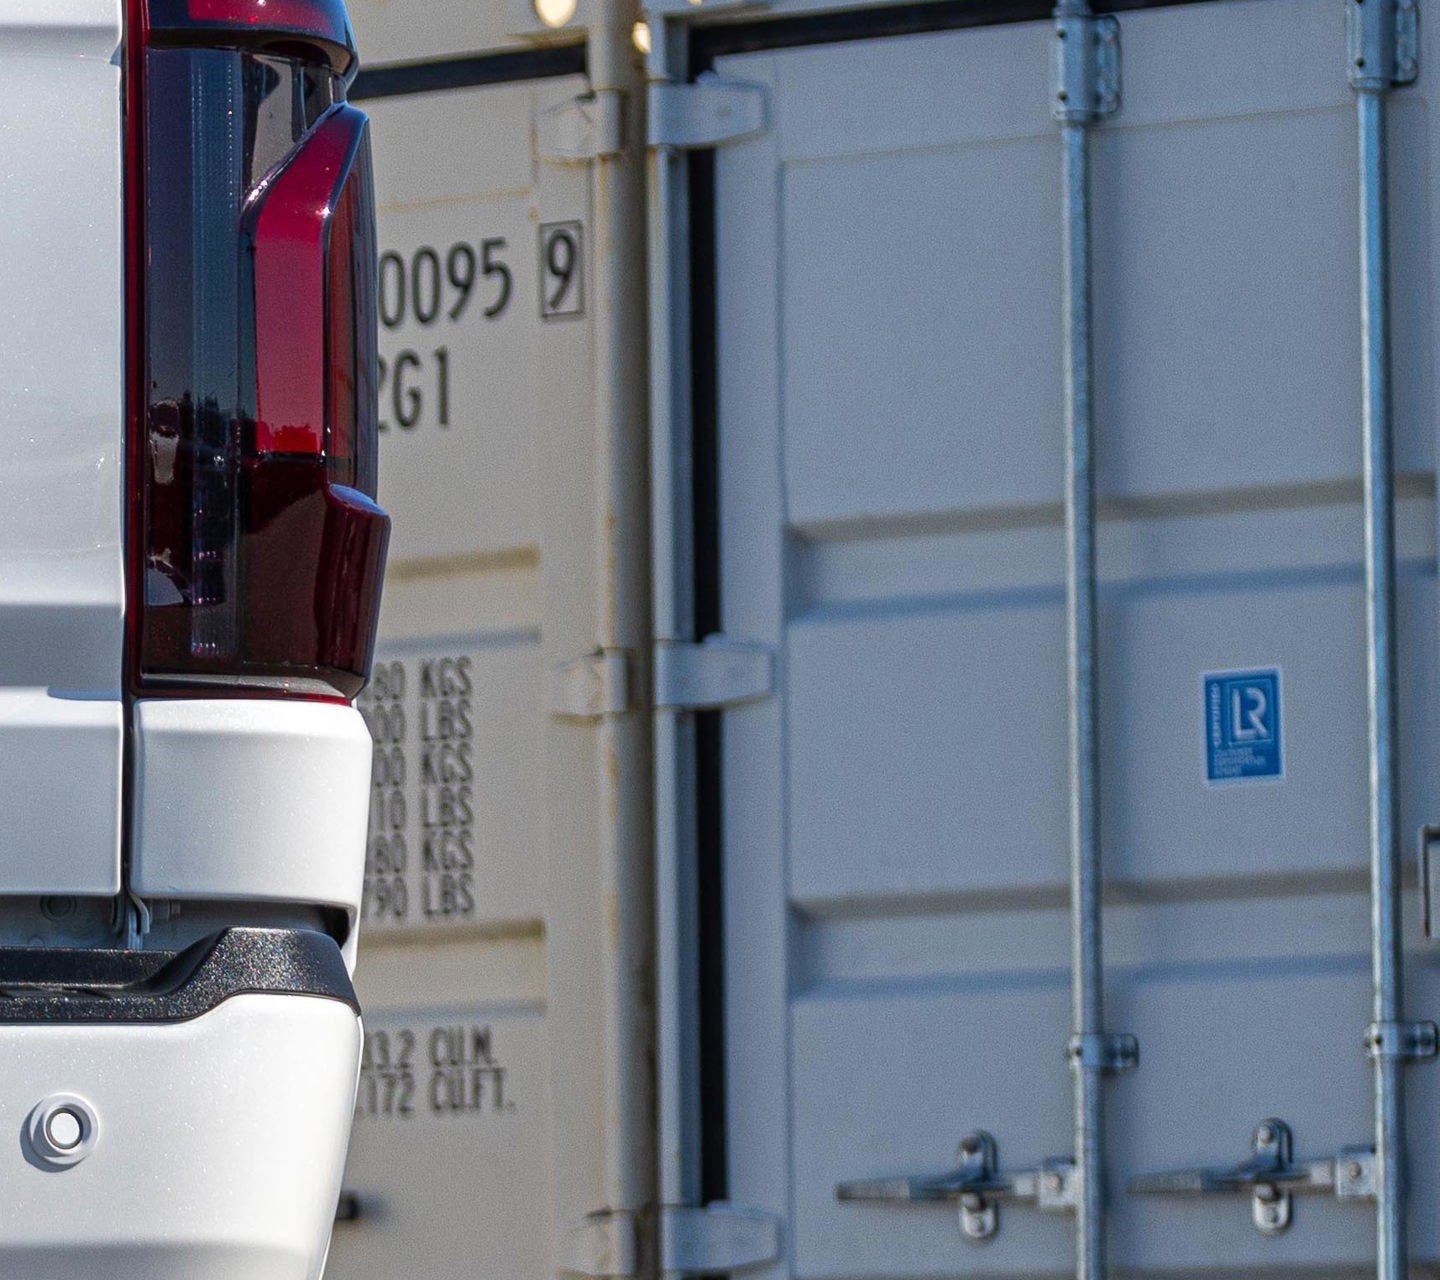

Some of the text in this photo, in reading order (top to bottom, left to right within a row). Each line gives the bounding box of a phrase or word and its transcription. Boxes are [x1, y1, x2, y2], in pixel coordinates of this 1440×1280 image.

[379, 227, 579, 328] 0095 9
[420, 655, 473, 699] KGS
[420, 698, 474, 742] LBS
[421, 741, 474, 785] KGS
[421, 785, 475, 829] LBS
[421, 828, 475, 872] KGS
[421, 872, 476, 917] LBS
